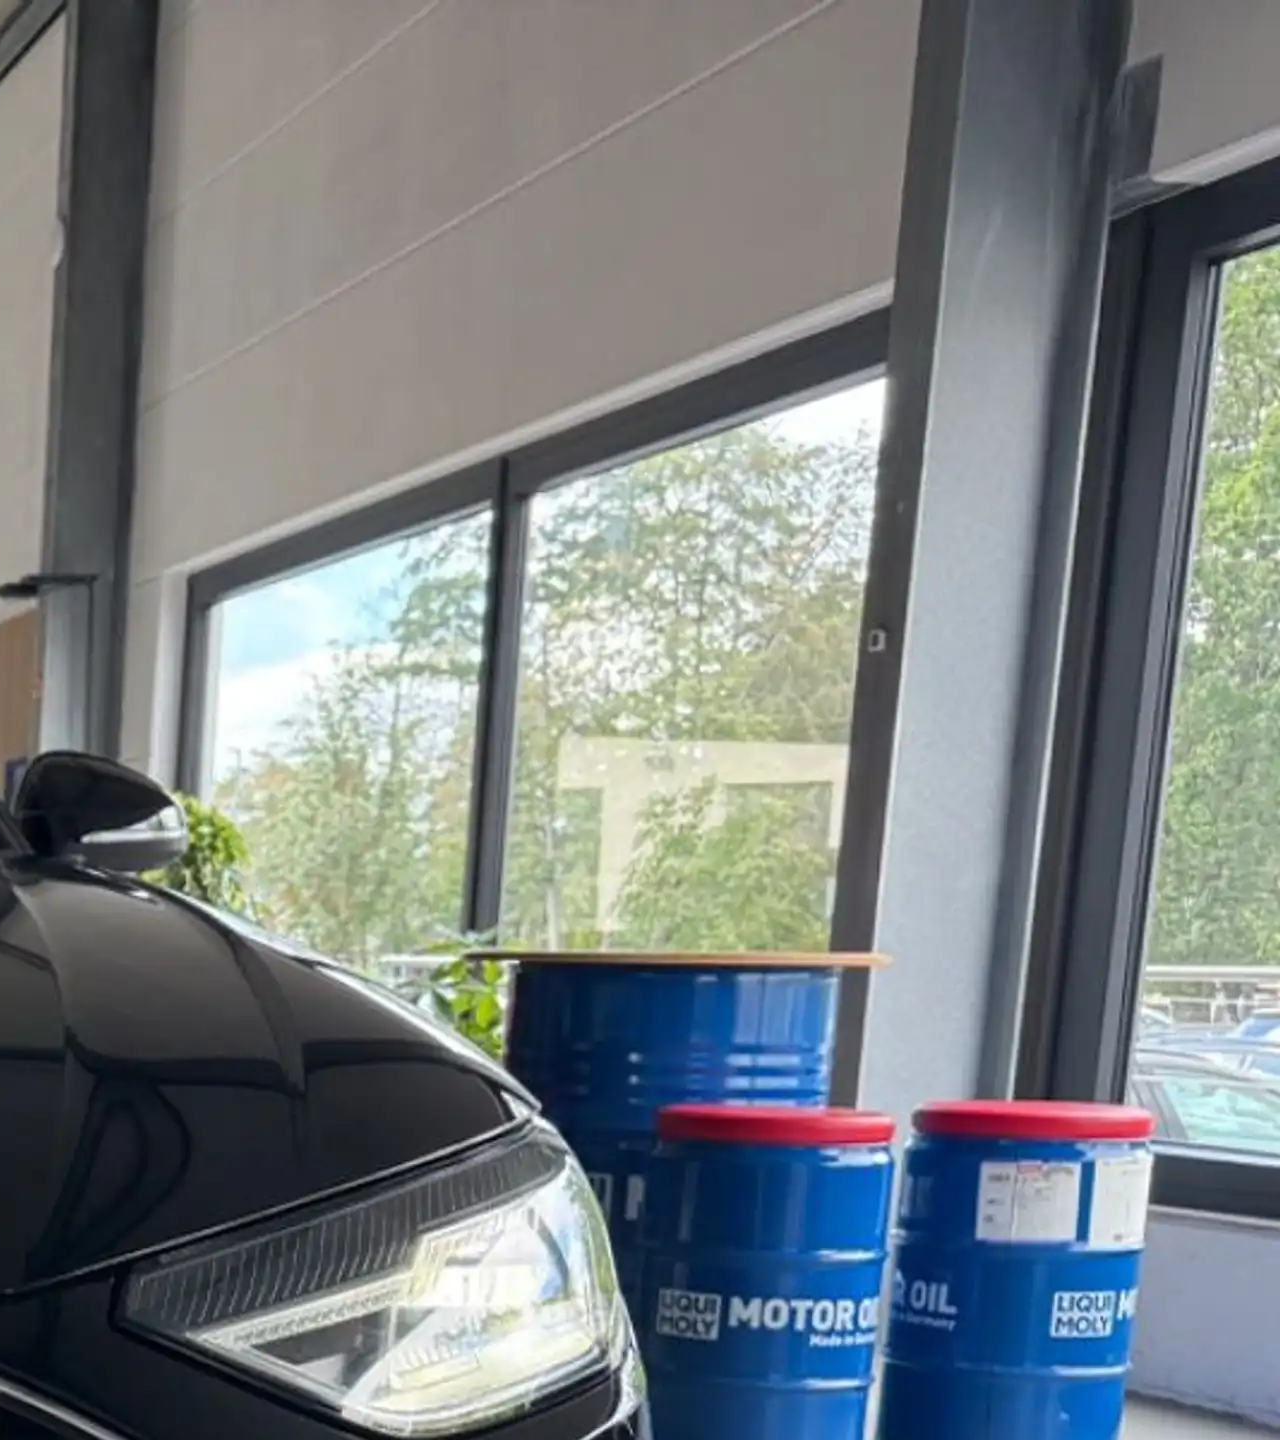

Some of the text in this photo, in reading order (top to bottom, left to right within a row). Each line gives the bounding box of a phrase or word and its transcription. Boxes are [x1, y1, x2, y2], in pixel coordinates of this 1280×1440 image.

[909, 1279, 958, 1316] OIL
[1057, 1293, 1112, 1313] LIQUI
[727, 1295, 855, 1332] MOTOR
[1054, 1314, 1108, 1335] MOLY
[660, 1314, 715, 1337] MOLY
